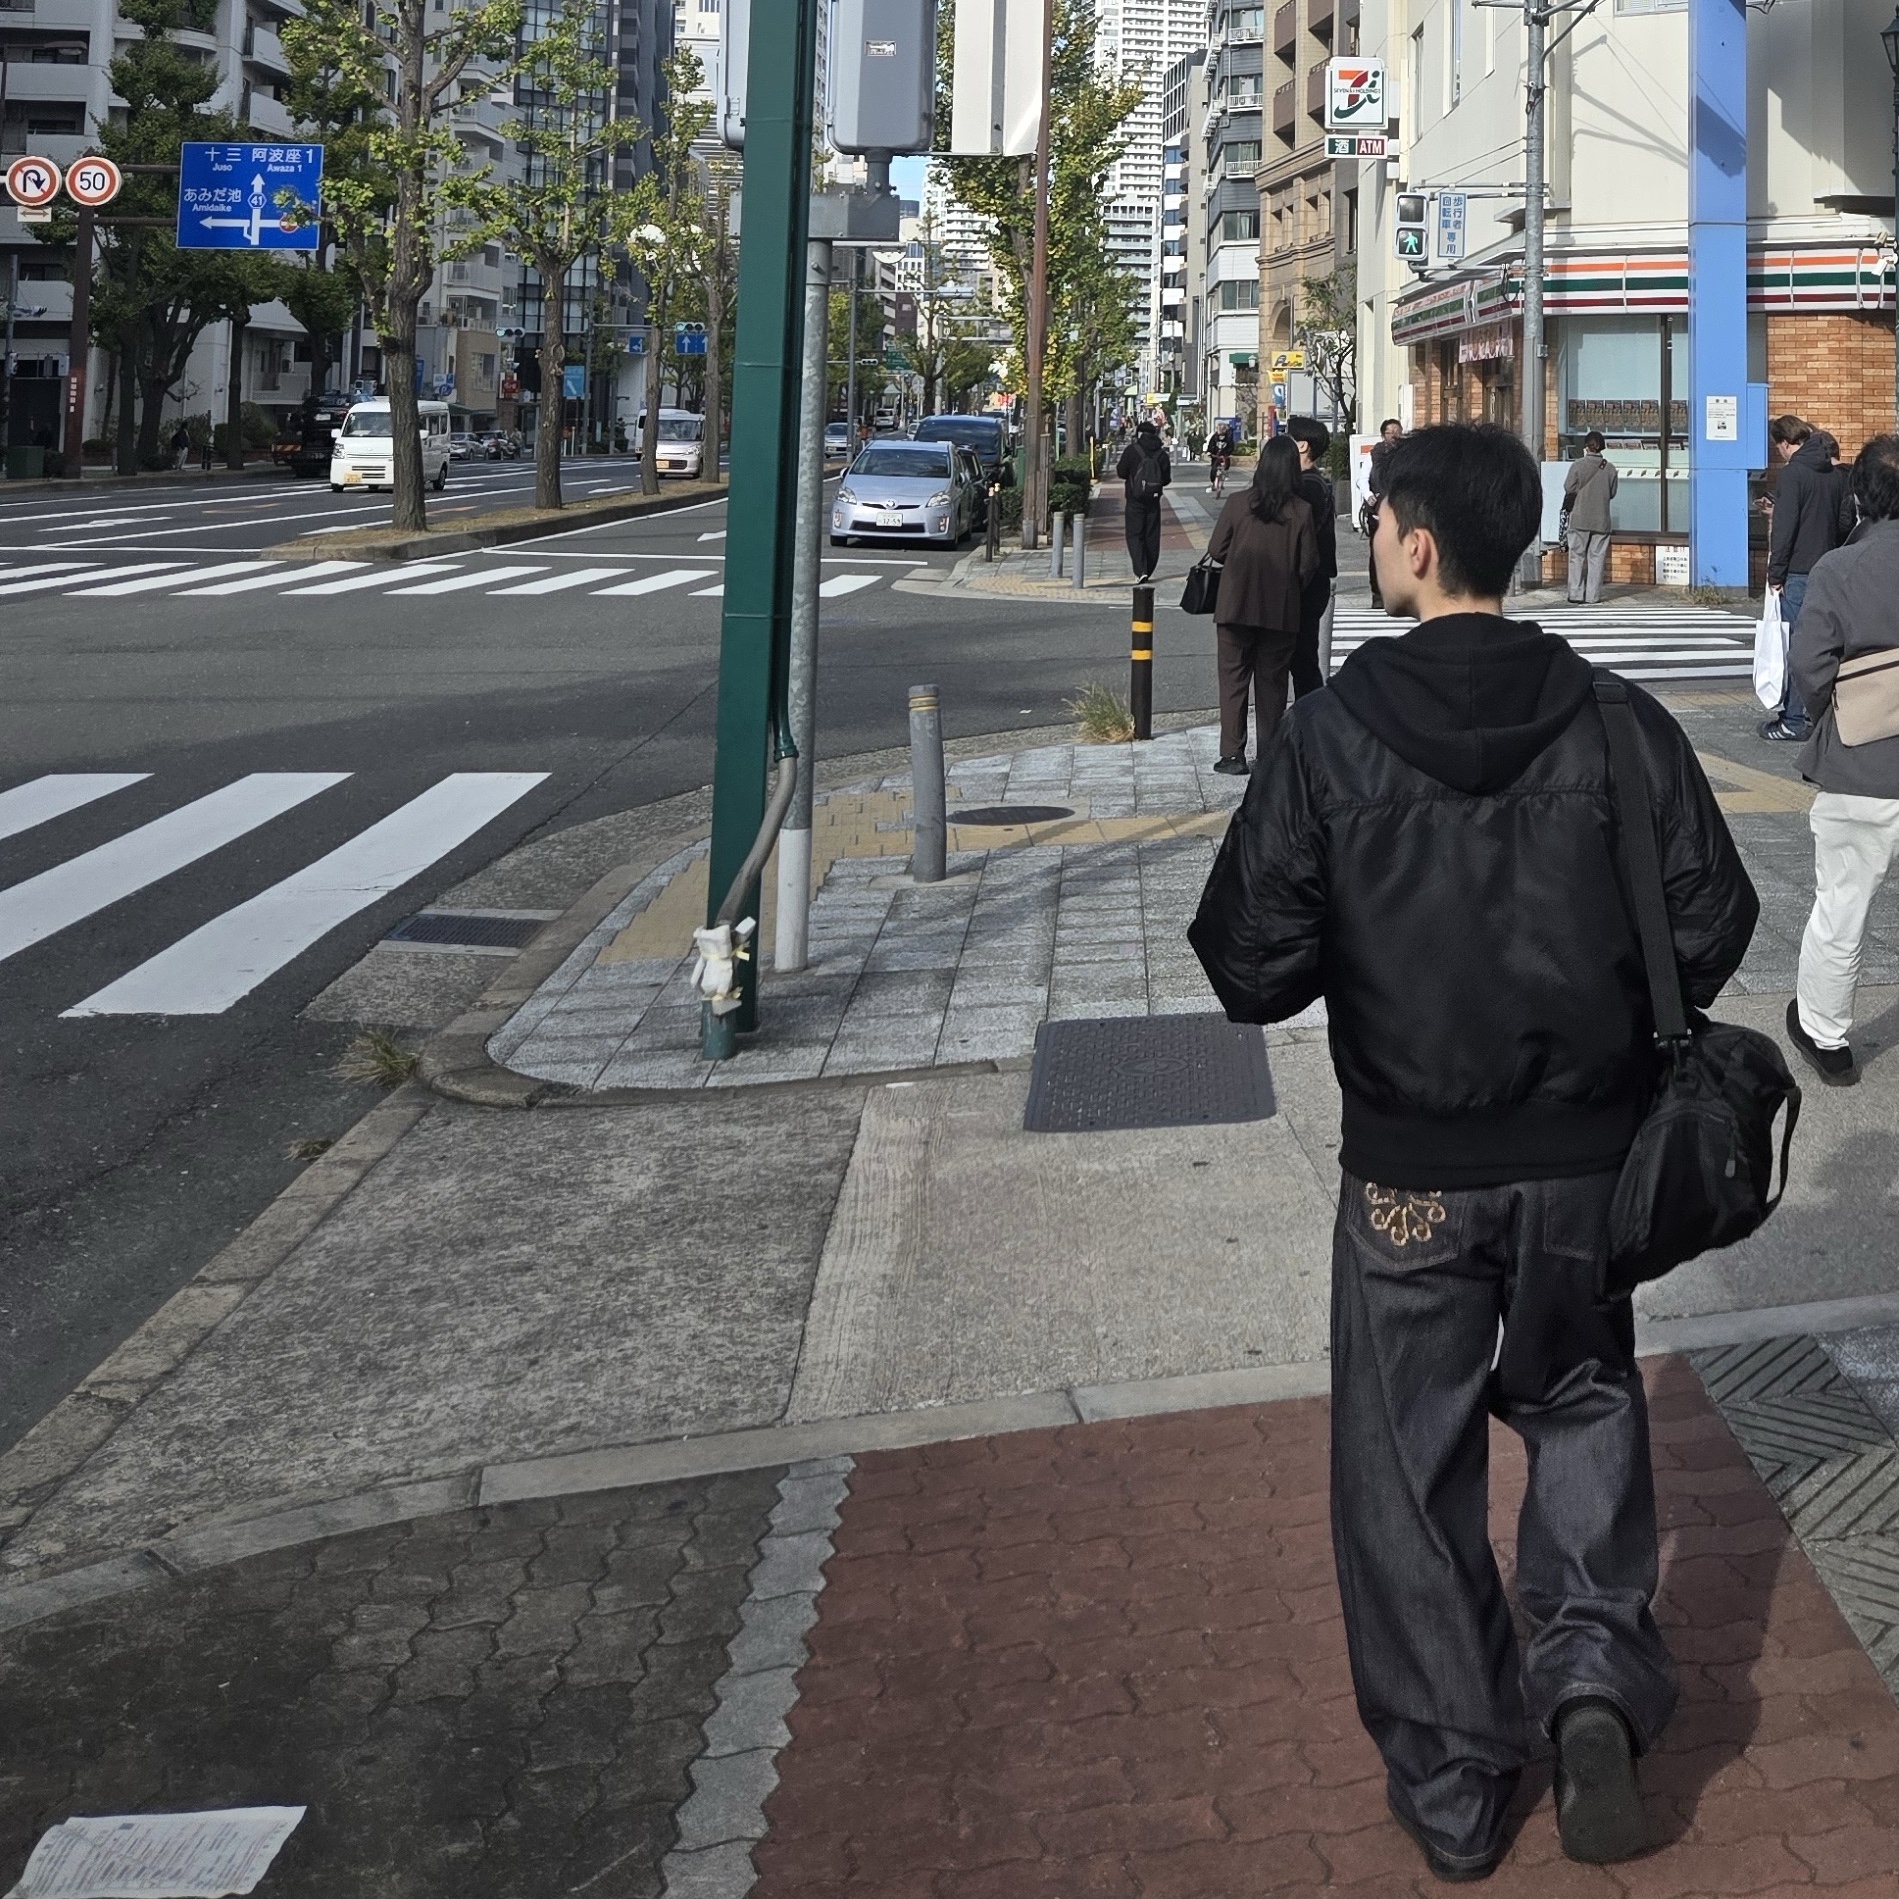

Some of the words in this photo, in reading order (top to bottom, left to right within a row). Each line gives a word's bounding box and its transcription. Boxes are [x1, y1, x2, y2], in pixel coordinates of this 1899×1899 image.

[1334, 139, 1350, 154] 酒
[1359, 140, 1382, 154] ATM
[205, 147, 242, 162] 十三
[212, 163, 233, 172] Juso
[267, 164, 295, 173] Awaza
[297, 165, 302, 173] 1
[79, 171, 106, 191] 50
[183, 187, 242, 203] あみだ池
[251, 195, 263, 206] 41
[192, 203, 232, 212] Amidaike
[1442, 196, 1451, 229] 自転車
[1453, 196, 1463, 229] 歩行者
[1446, 231, 1457, 254] 専用
